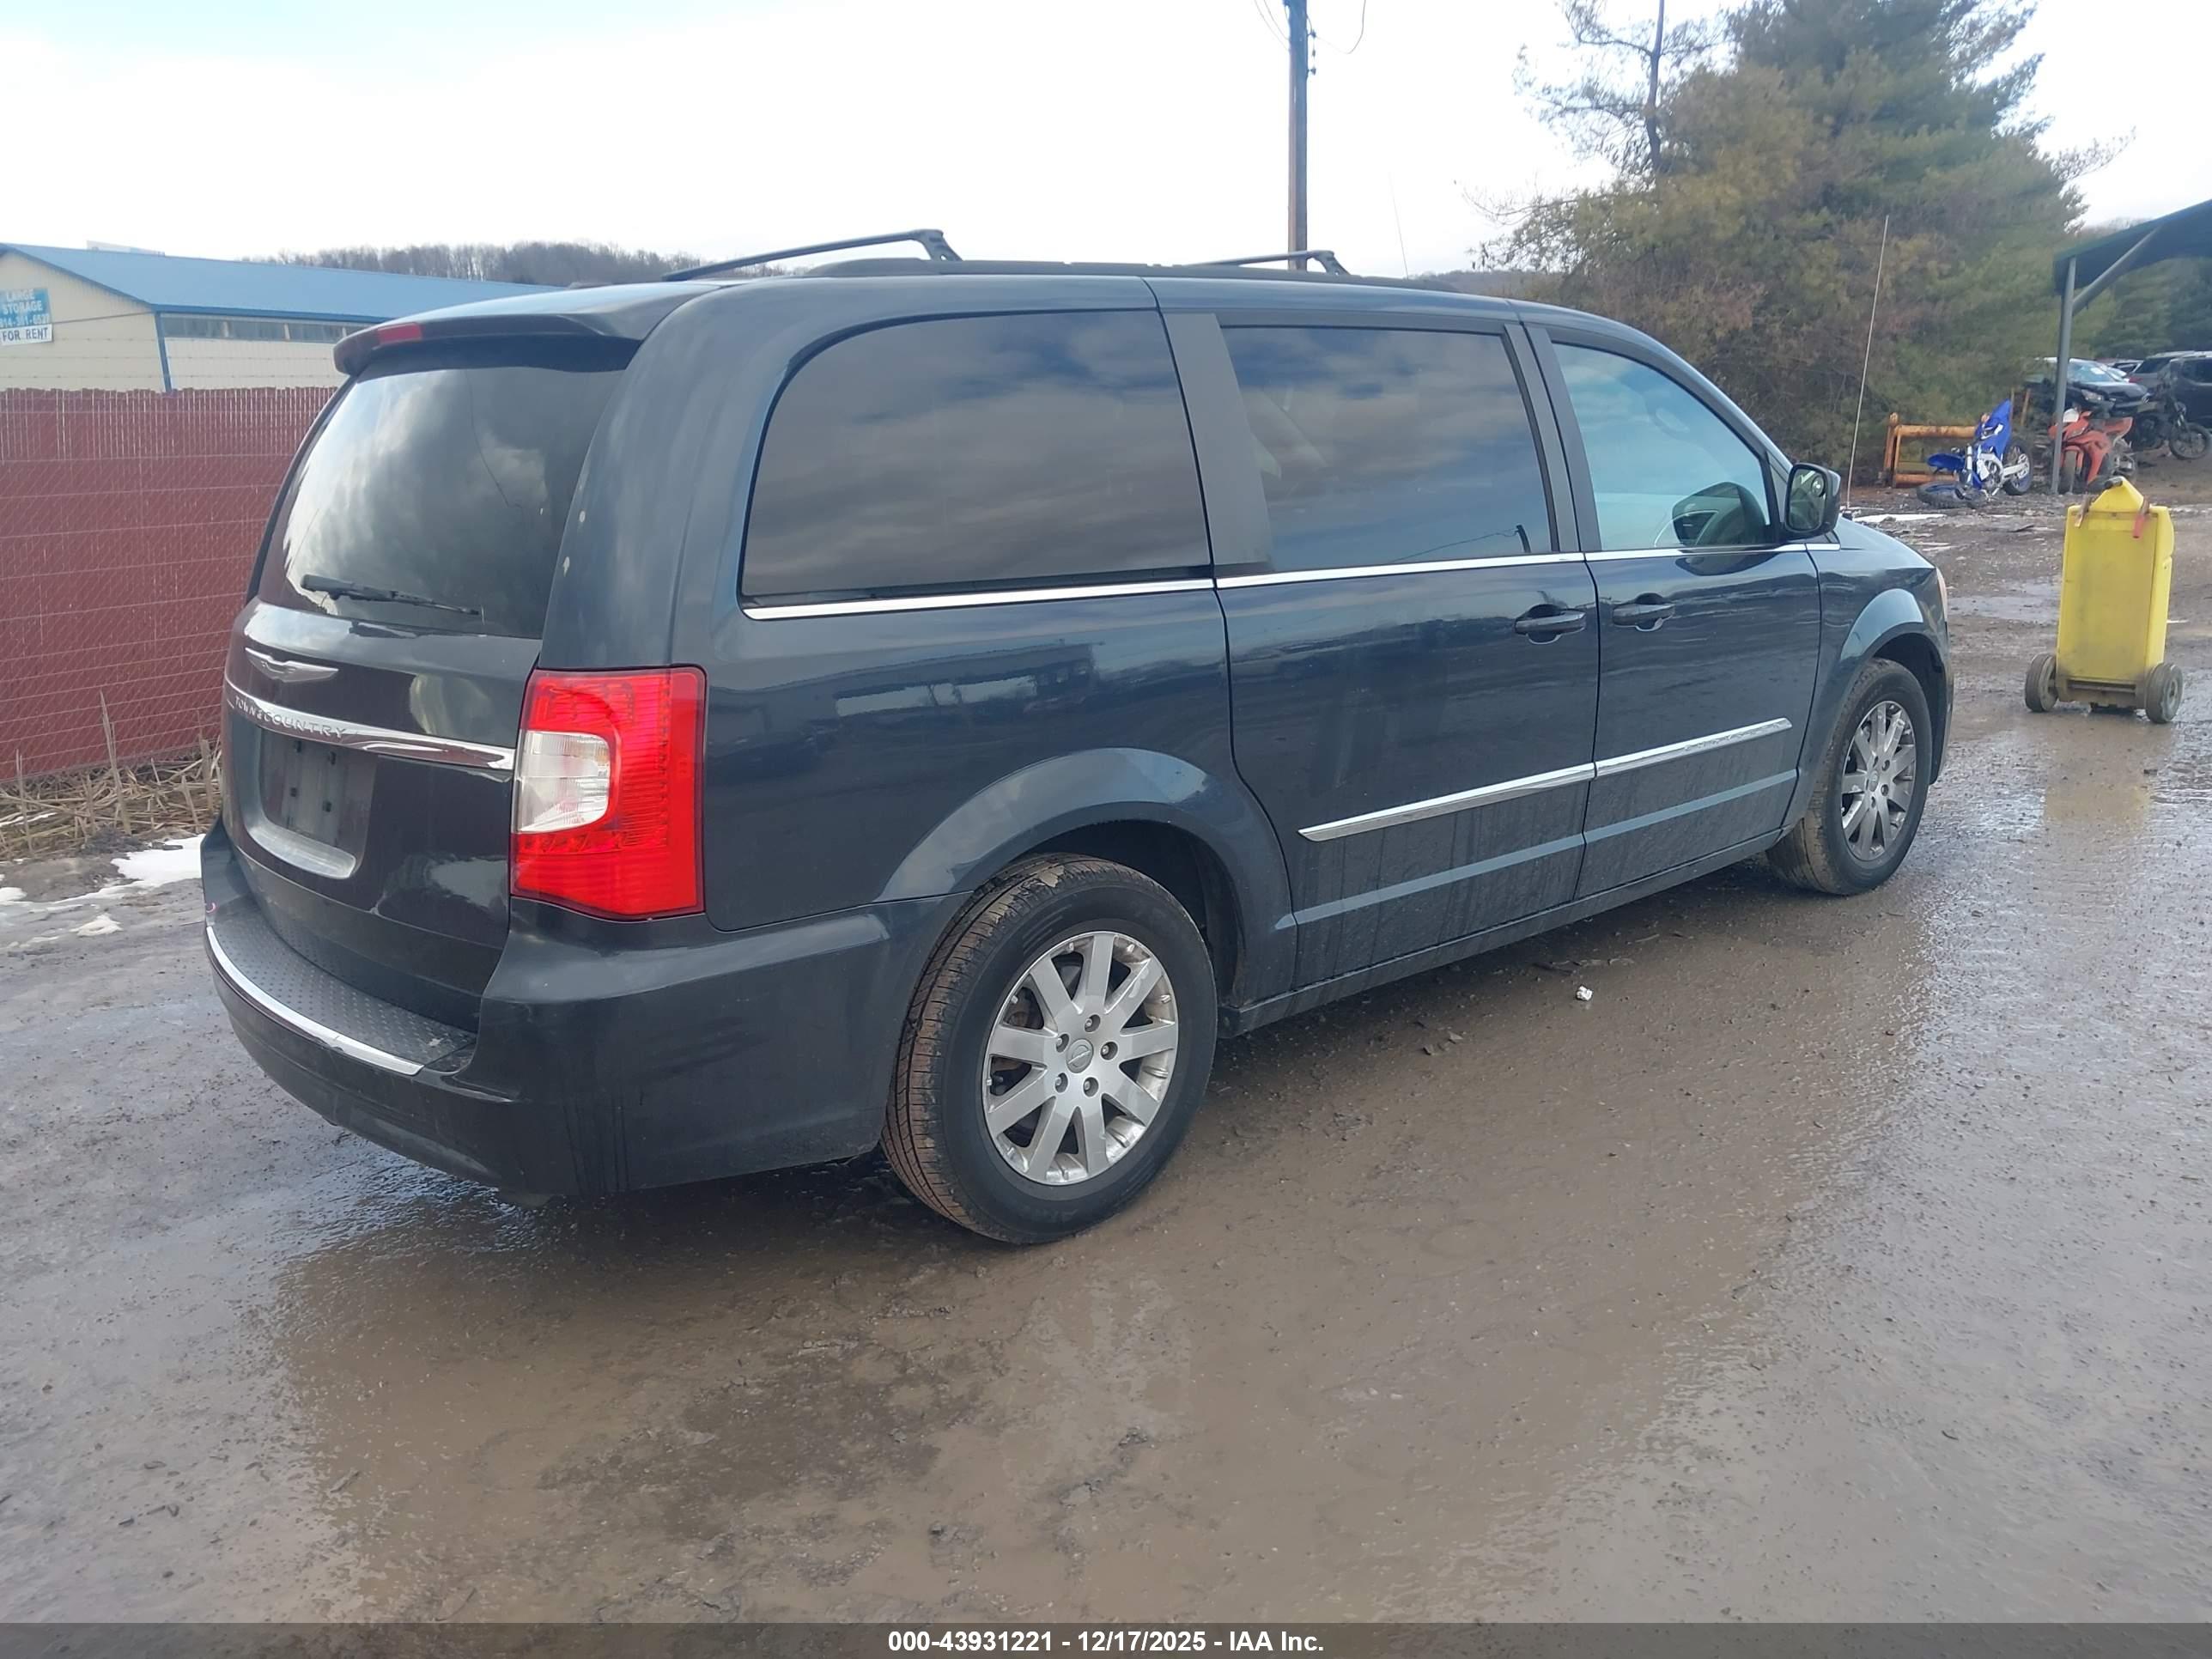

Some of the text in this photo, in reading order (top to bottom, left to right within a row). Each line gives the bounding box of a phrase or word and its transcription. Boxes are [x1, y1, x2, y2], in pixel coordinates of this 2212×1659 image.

[3, 300, 44, 315] STORAGE
[2, 327, 48, 342] FOR RENT
